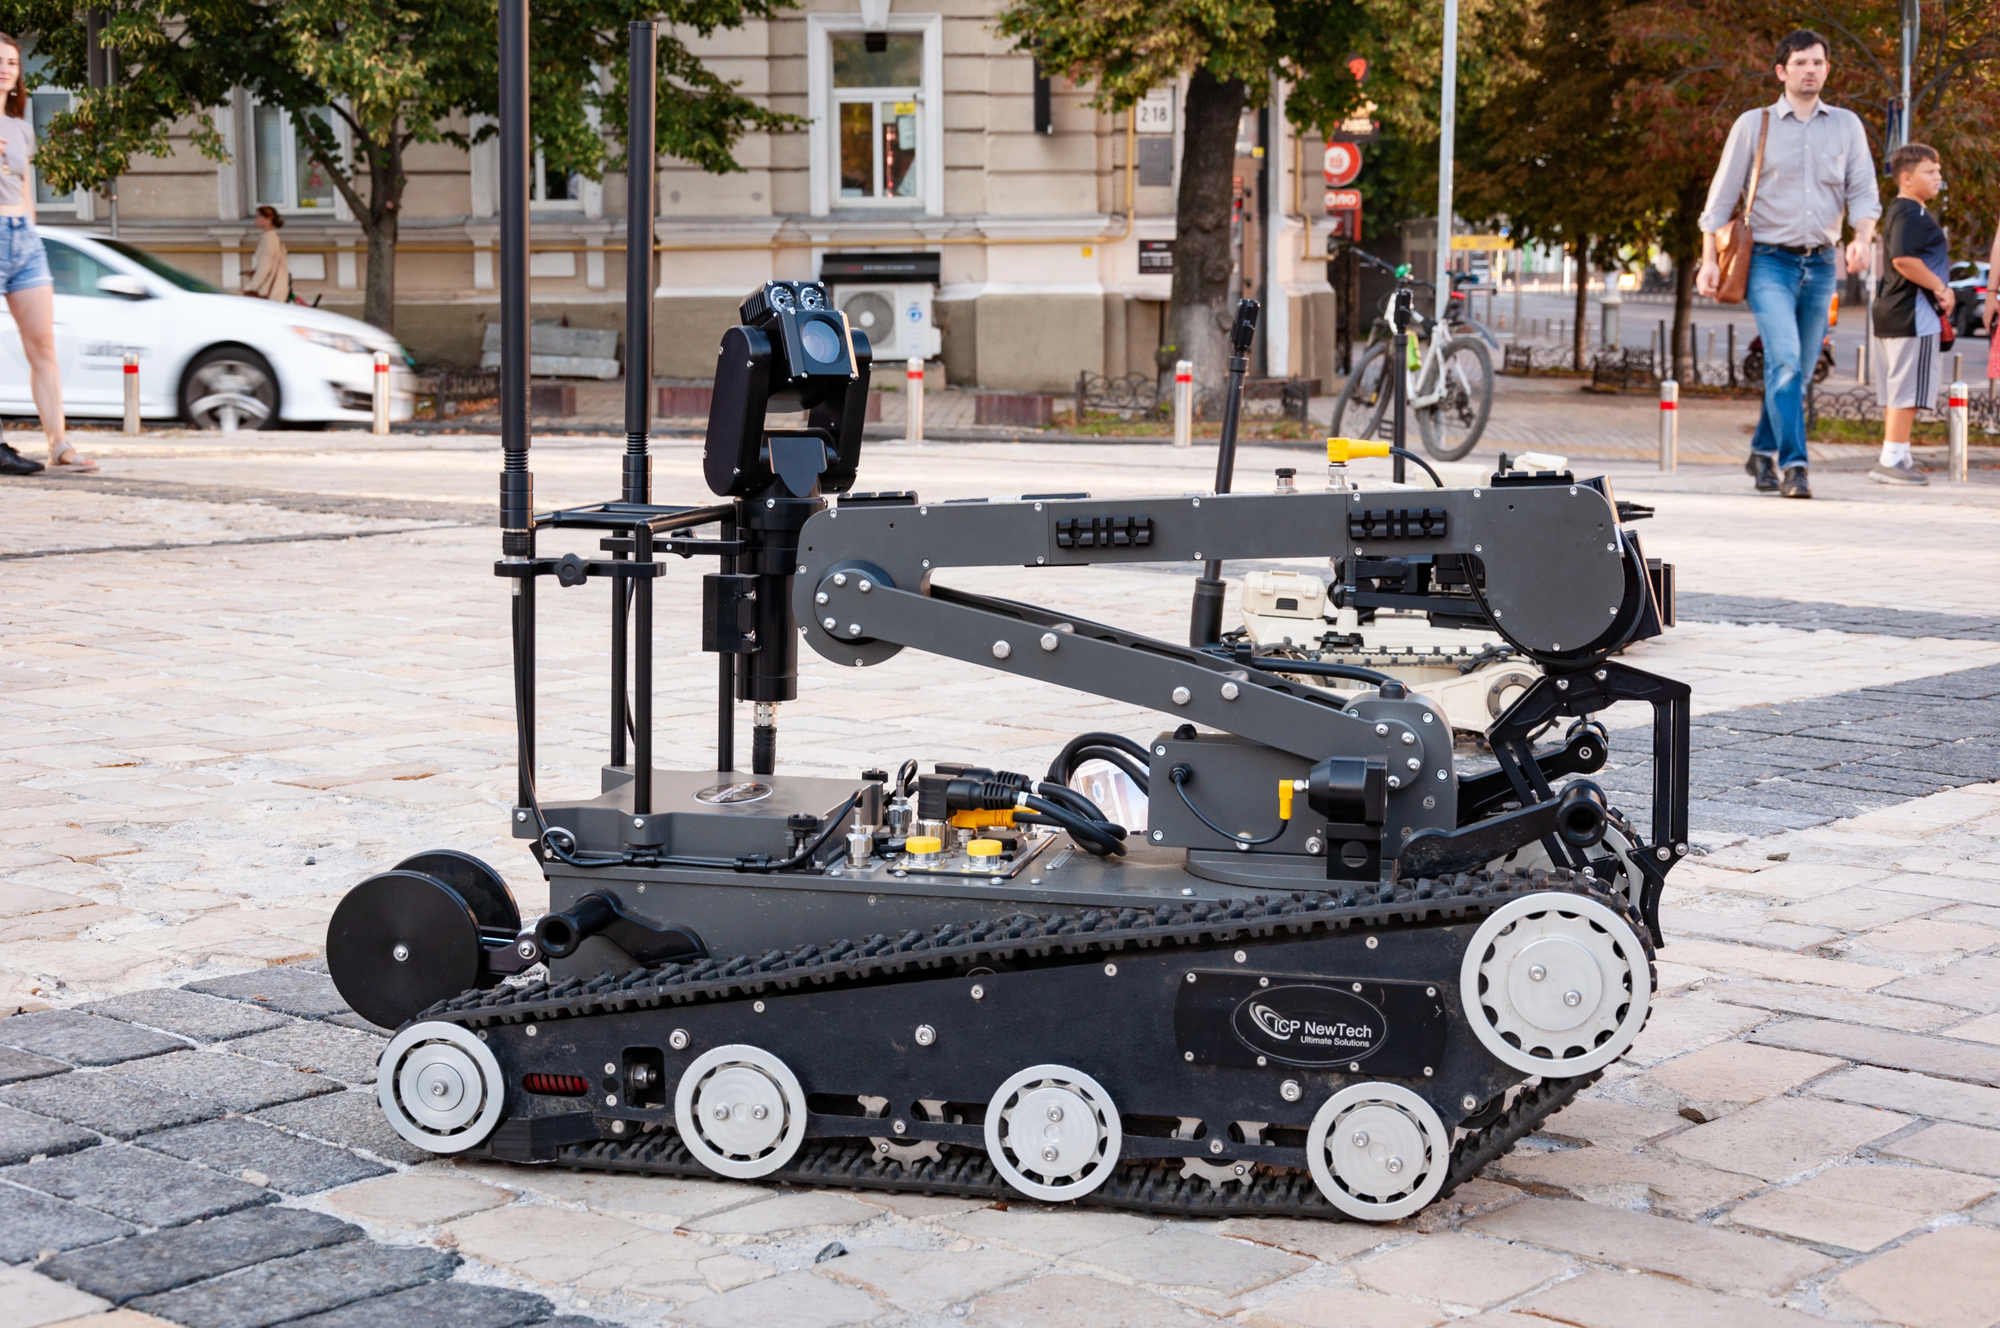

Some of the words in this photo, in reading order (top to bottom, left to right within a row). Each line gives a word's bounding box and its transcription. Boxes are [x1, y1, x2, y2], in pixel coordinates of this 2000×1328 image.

[1275, 1019, 1300, 1033] ICP
[1305, 1021, 1372, 1038] NewTech
[1300, 1036, 1332, 1045] Ultimate
[1333, 1038, 1370, 1047] Solutions
